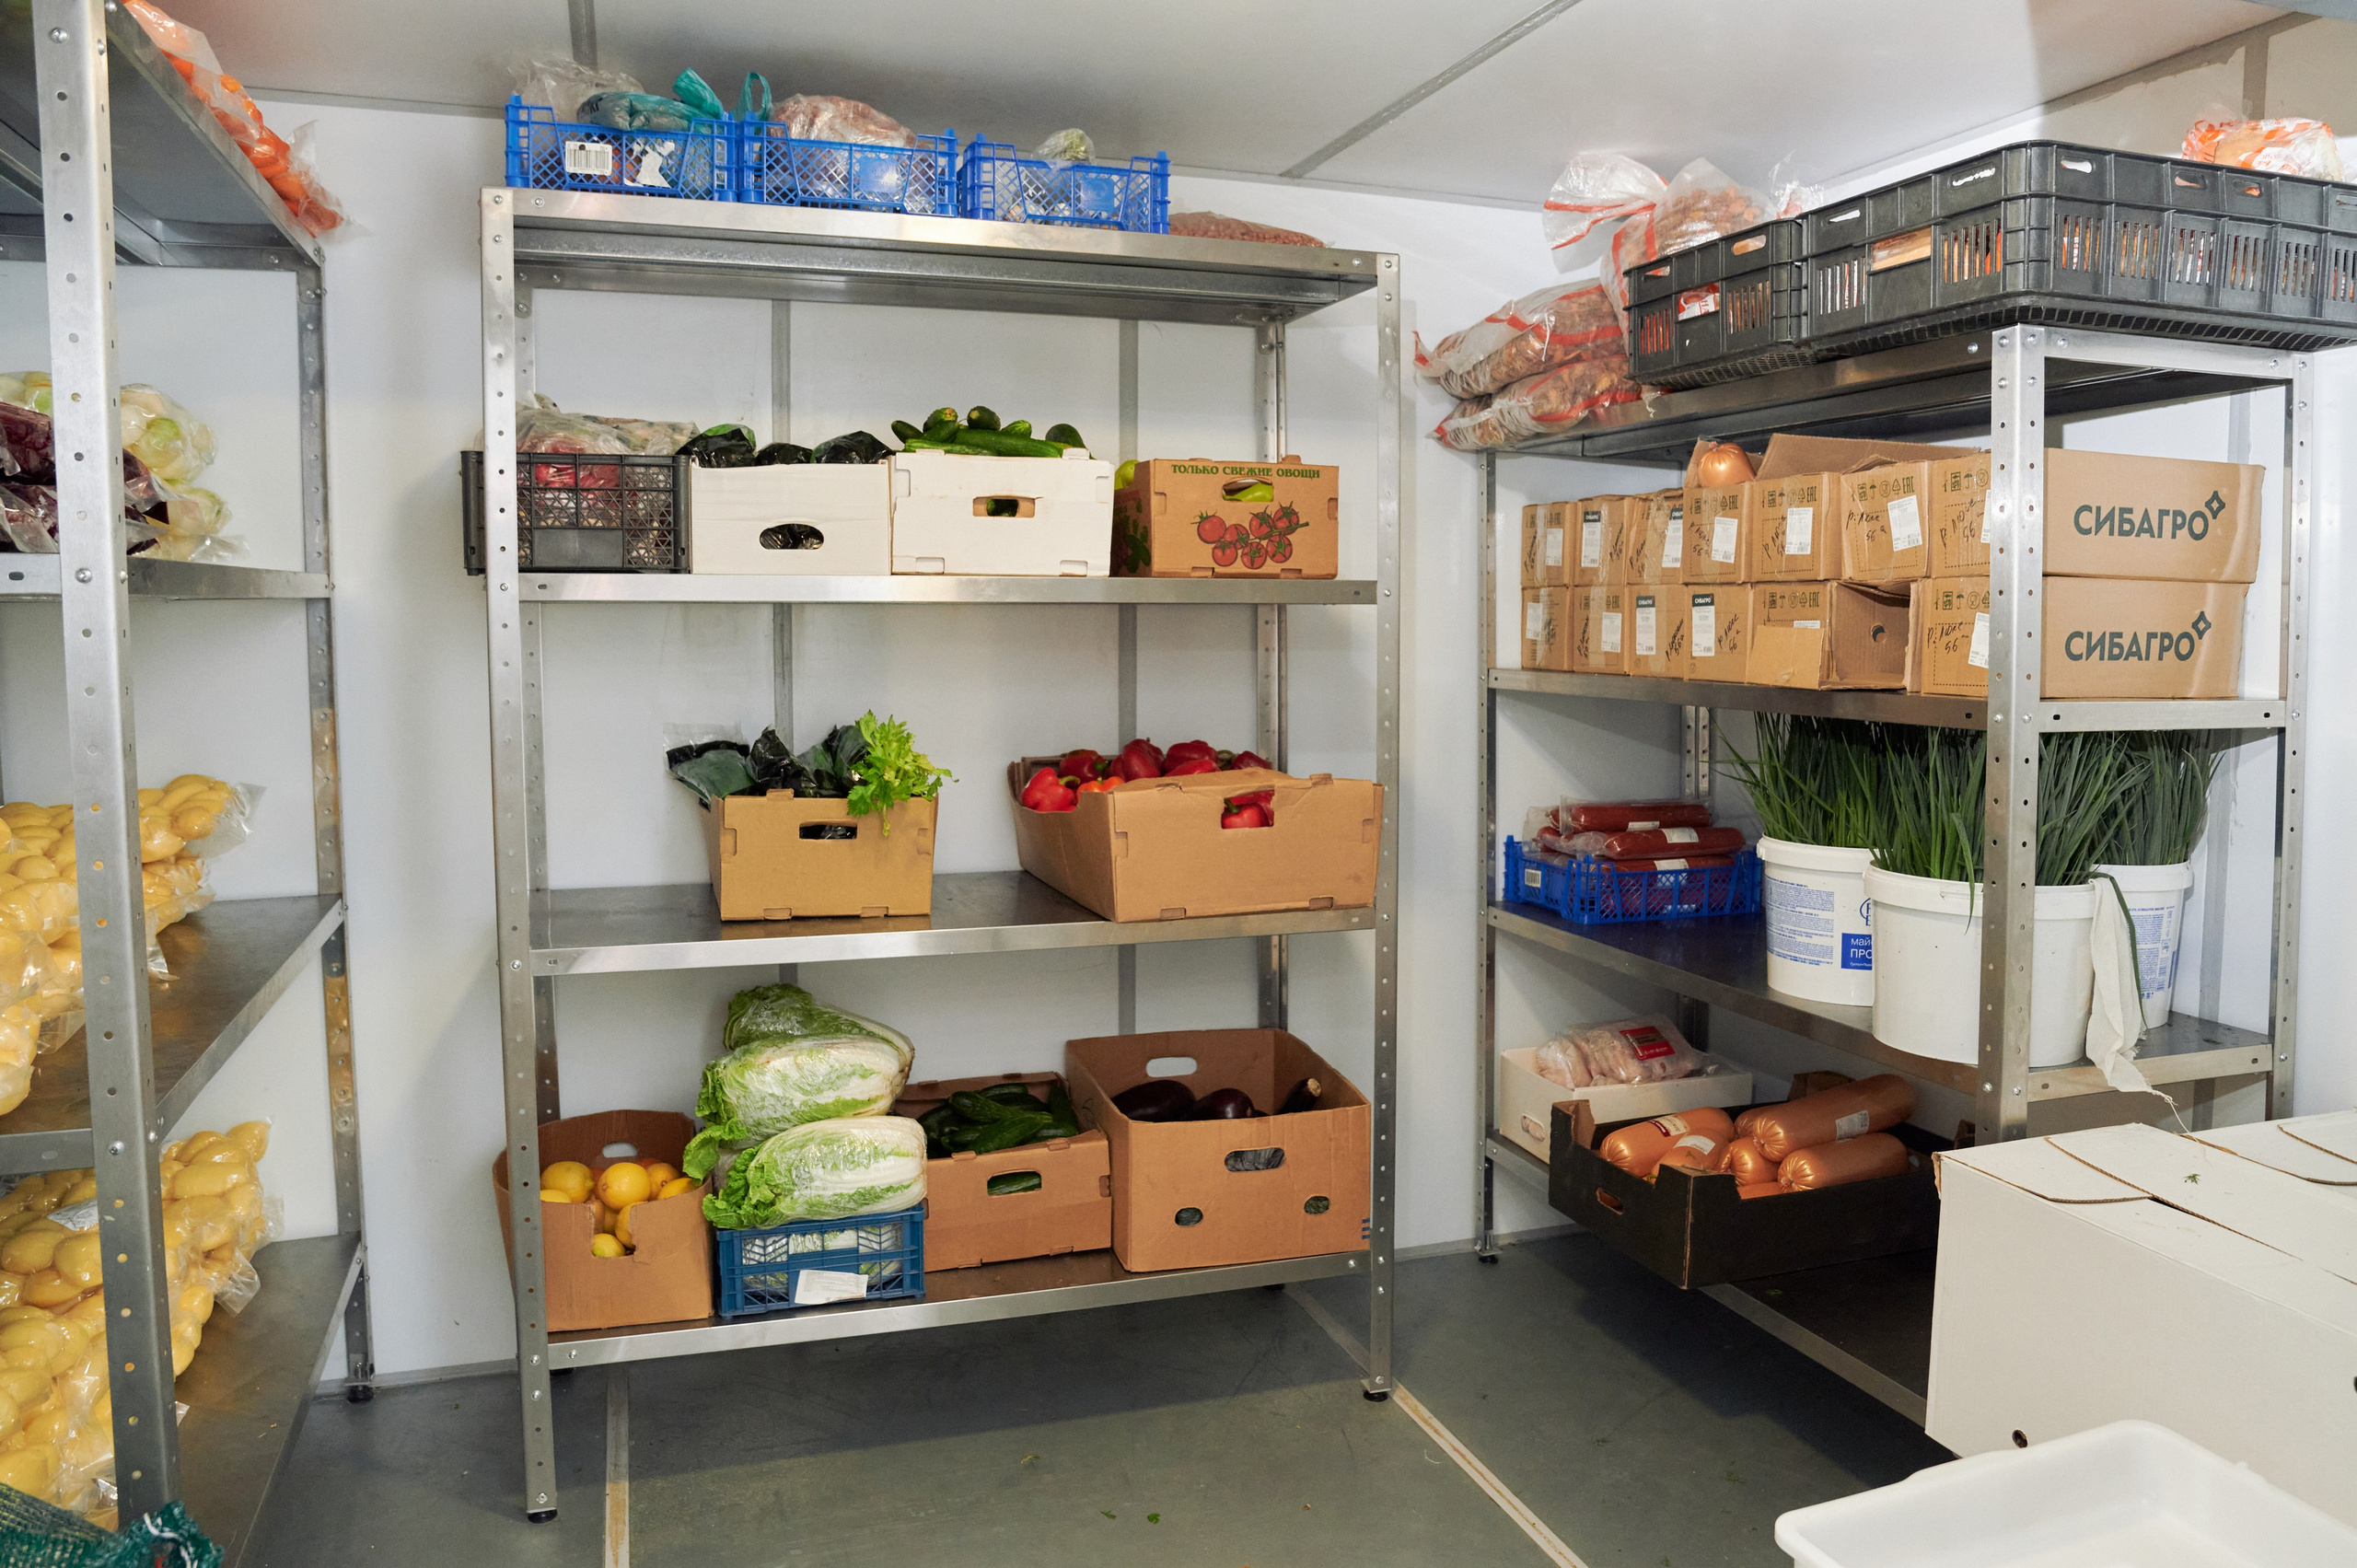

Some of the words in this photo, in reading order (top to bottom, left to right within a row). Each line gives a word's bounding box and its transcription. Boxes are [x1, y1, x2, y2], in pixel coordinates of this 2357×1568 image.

[1171, 464, 1219, 475] ТОЛЬКО
[1222, 466, 1273, 477] СВЕЖИЕ
[1276, 468, 1321, 479] ОВОЩИ
[2073, 504, 2210, 541] СИБАГРО
[2064, 630, 2195, 662] СИБАГРО
[1851, 936, 1873, 947] май
